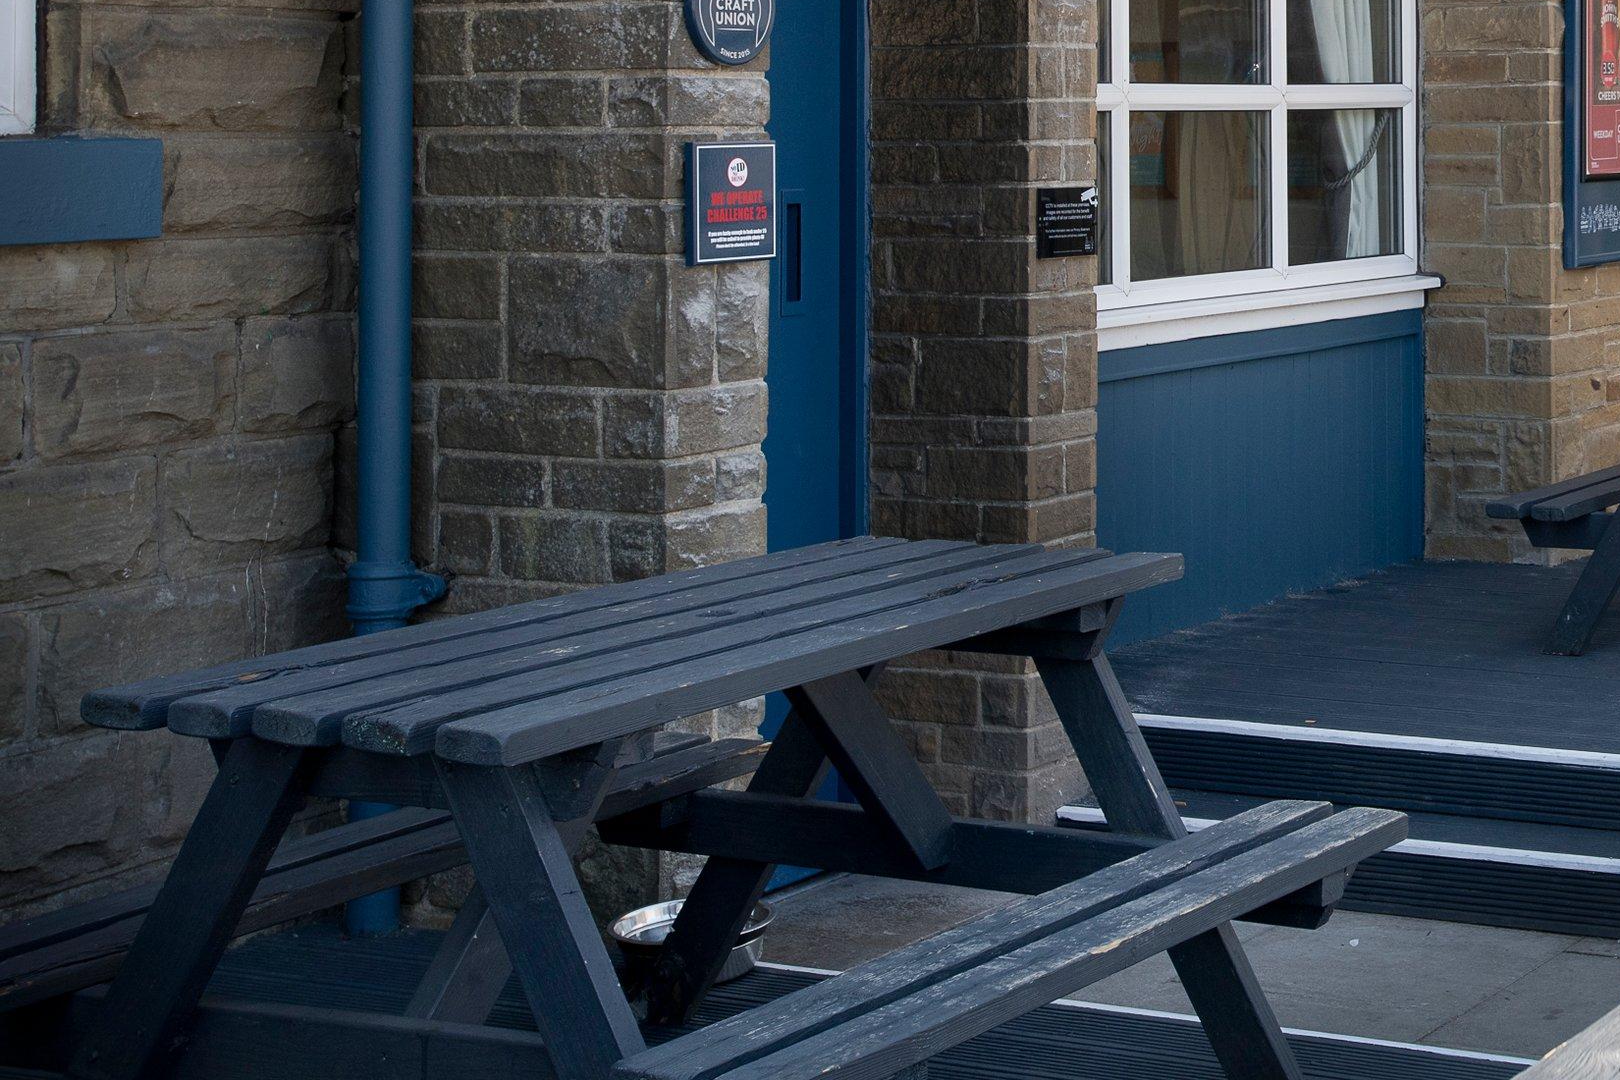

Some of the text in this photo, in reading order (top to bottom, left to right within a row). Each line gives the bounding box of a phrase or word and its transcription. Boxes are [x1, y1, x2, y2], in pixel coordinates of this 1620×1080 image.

[715, 11, 755, 26] UNION
[720, 47, 751, 59] SINCE 2015
[1598, 91, 1616, 101] CHEERS
[711, 190, 764, 206] WE OPERATE
[708, 206, 767, 223] CHALLENGE 25
